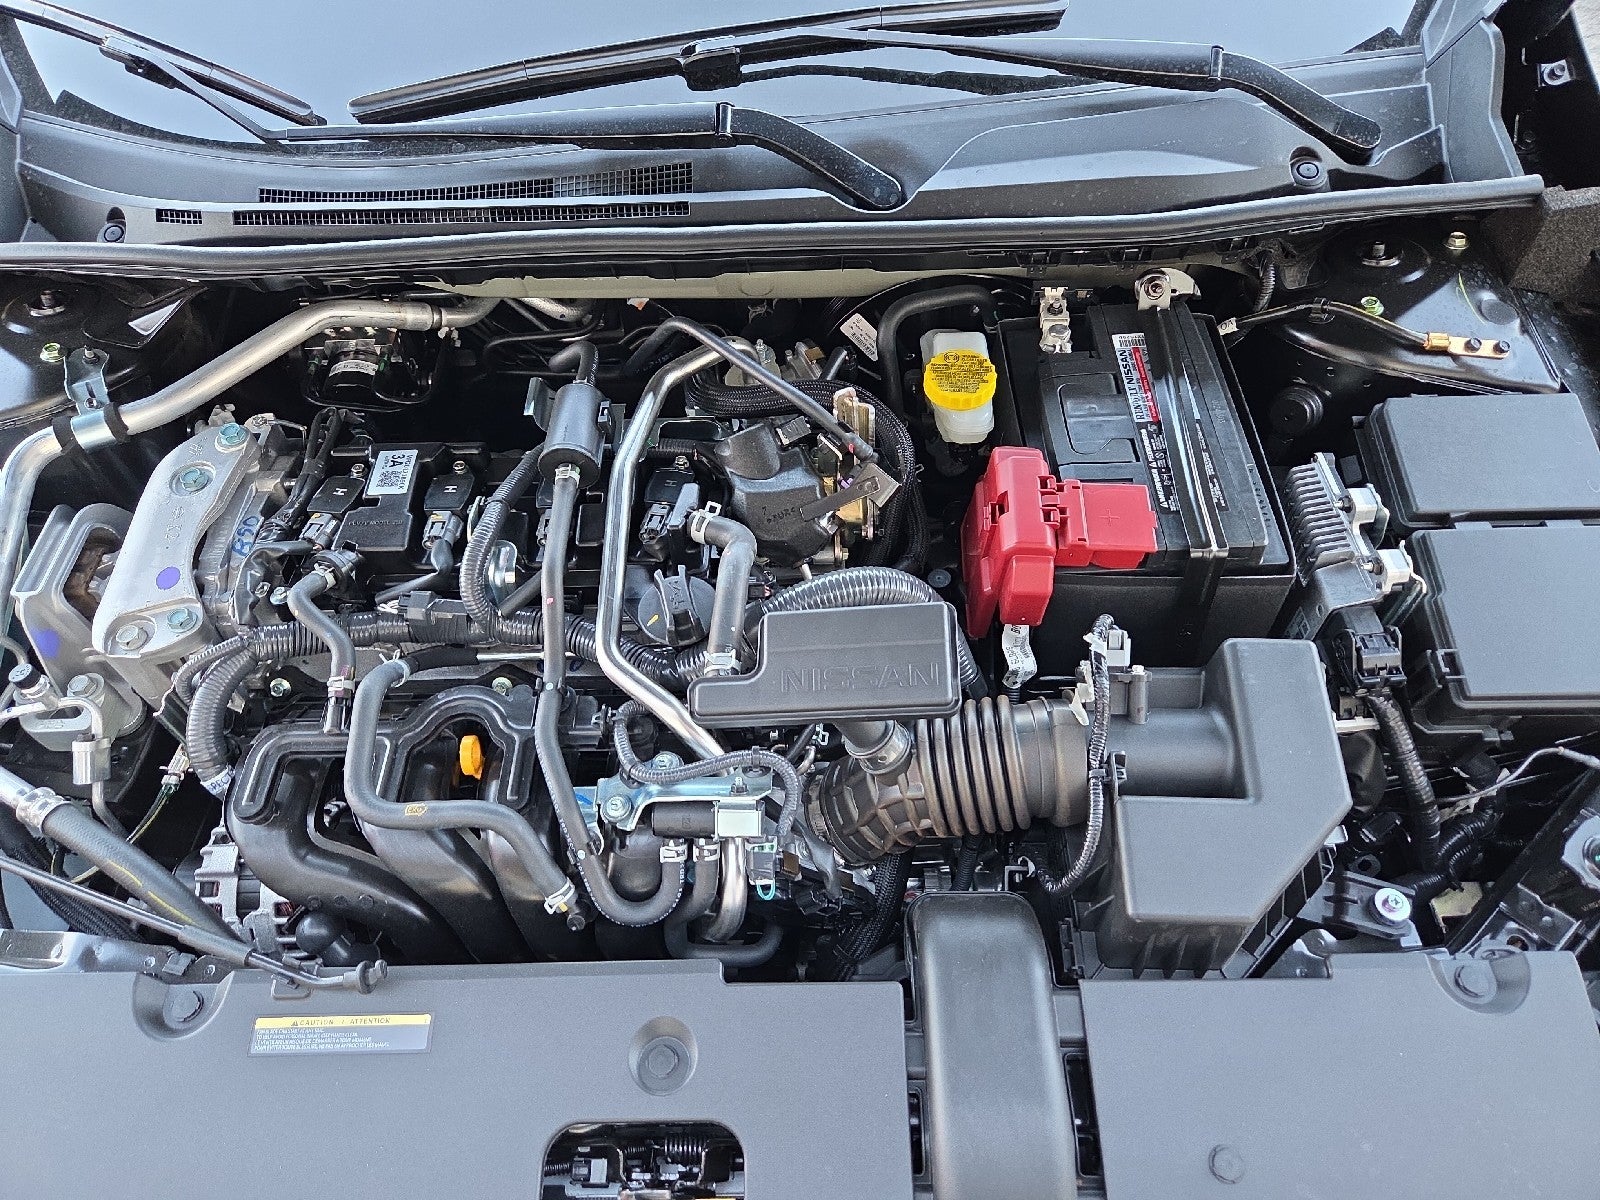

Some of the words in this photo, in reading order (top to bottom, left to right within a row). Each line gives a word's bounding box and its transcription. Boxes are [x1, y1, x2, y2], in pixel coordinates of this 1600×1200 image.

[1118, 349, 1135, 384] NISSAN
[389, 454, 405, 468] 3A
[781, 662, 940, 693] NISSAN
[349, 1017, 391, 1025] ATTENTION
